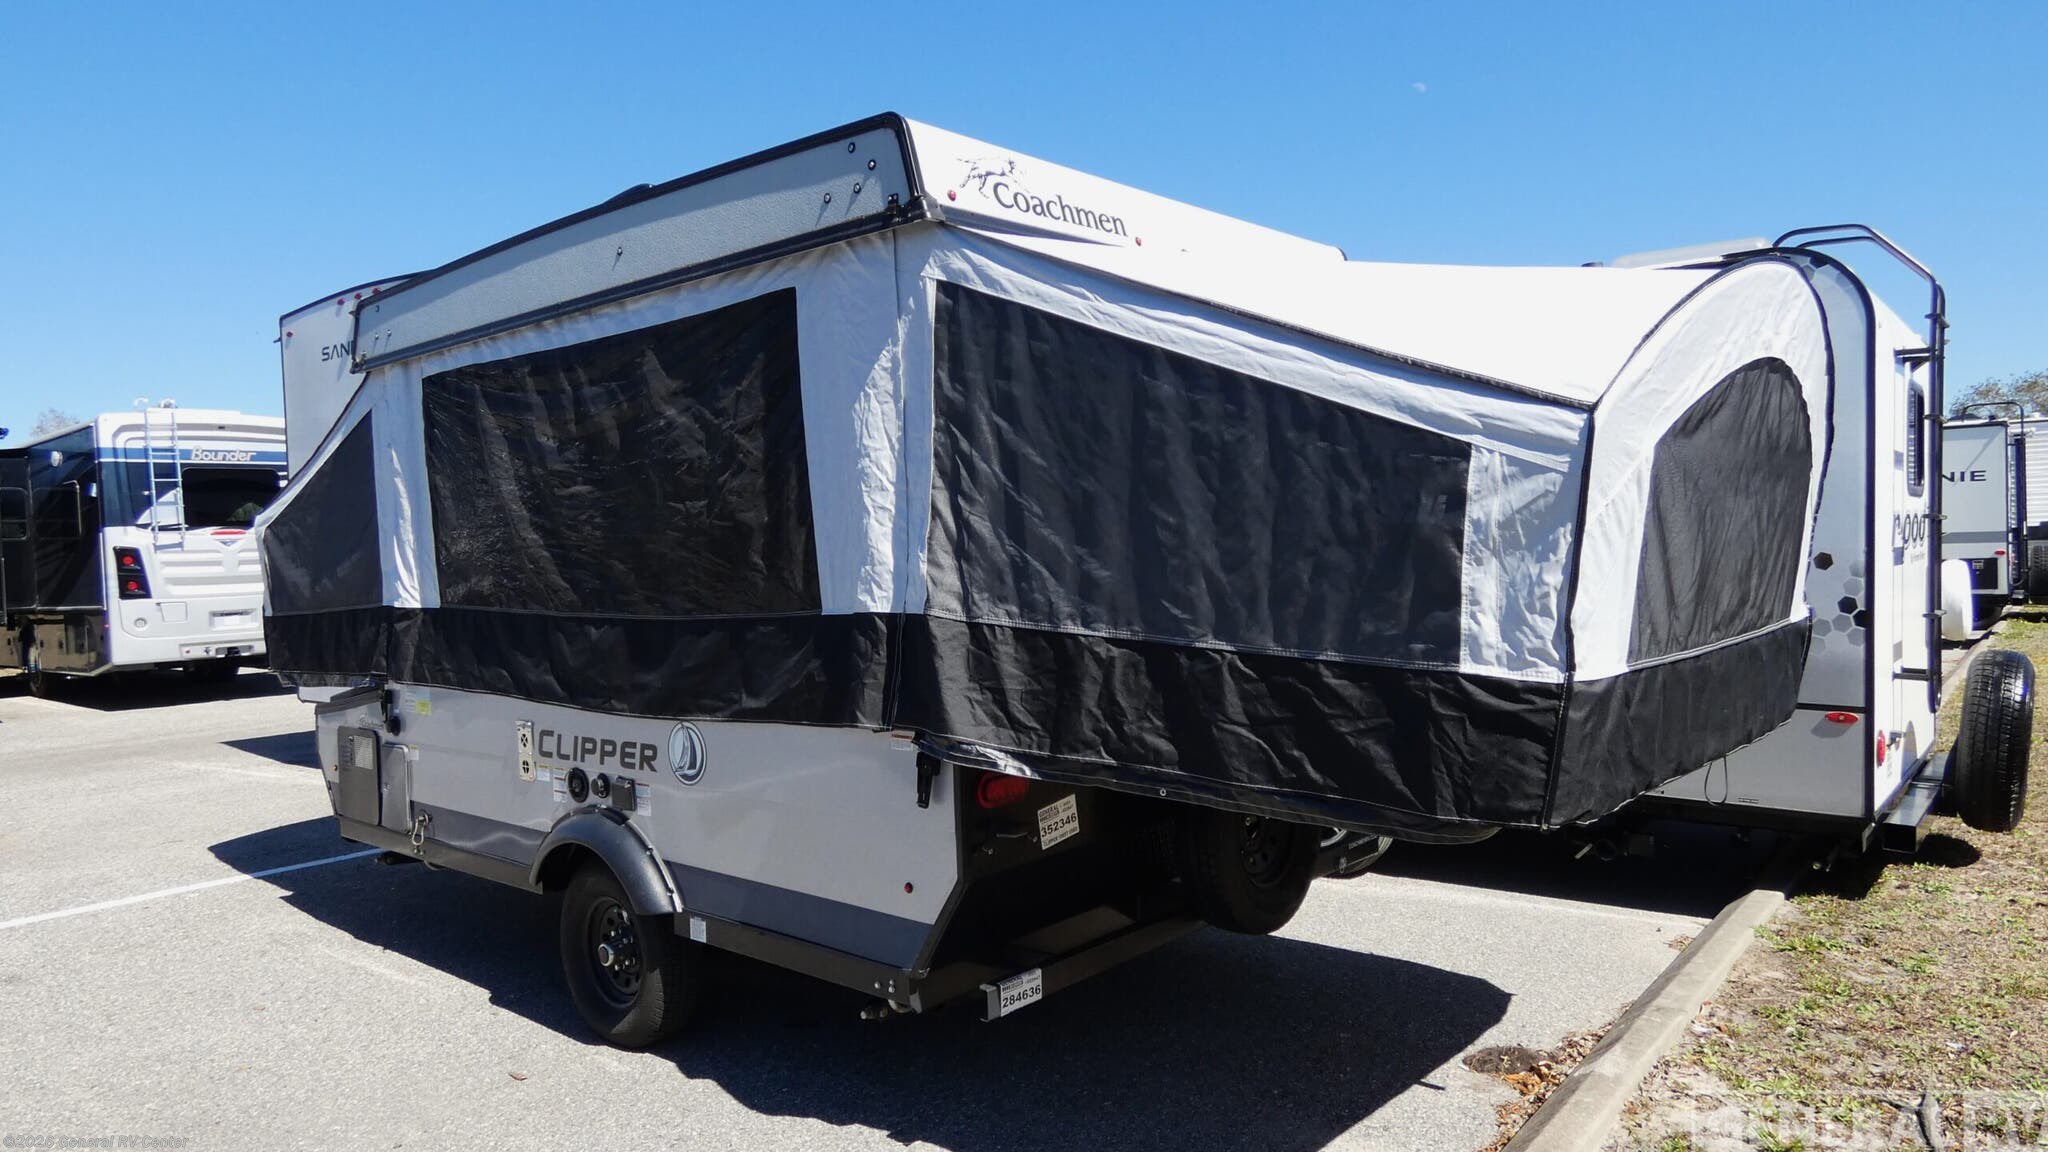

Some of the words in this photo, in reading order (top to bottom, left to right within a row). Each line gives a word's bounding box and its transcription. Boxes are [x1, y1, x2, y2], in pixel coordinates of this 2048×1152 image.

[992, 181, 1128, 237] Coachmen
[190, 446, 257, 462] Bounder
[538, 729, 658, 773] CLIPPER
[1041, 812, 1077, 838] 352346
[1002, 984, 1041, 1009] 284636
